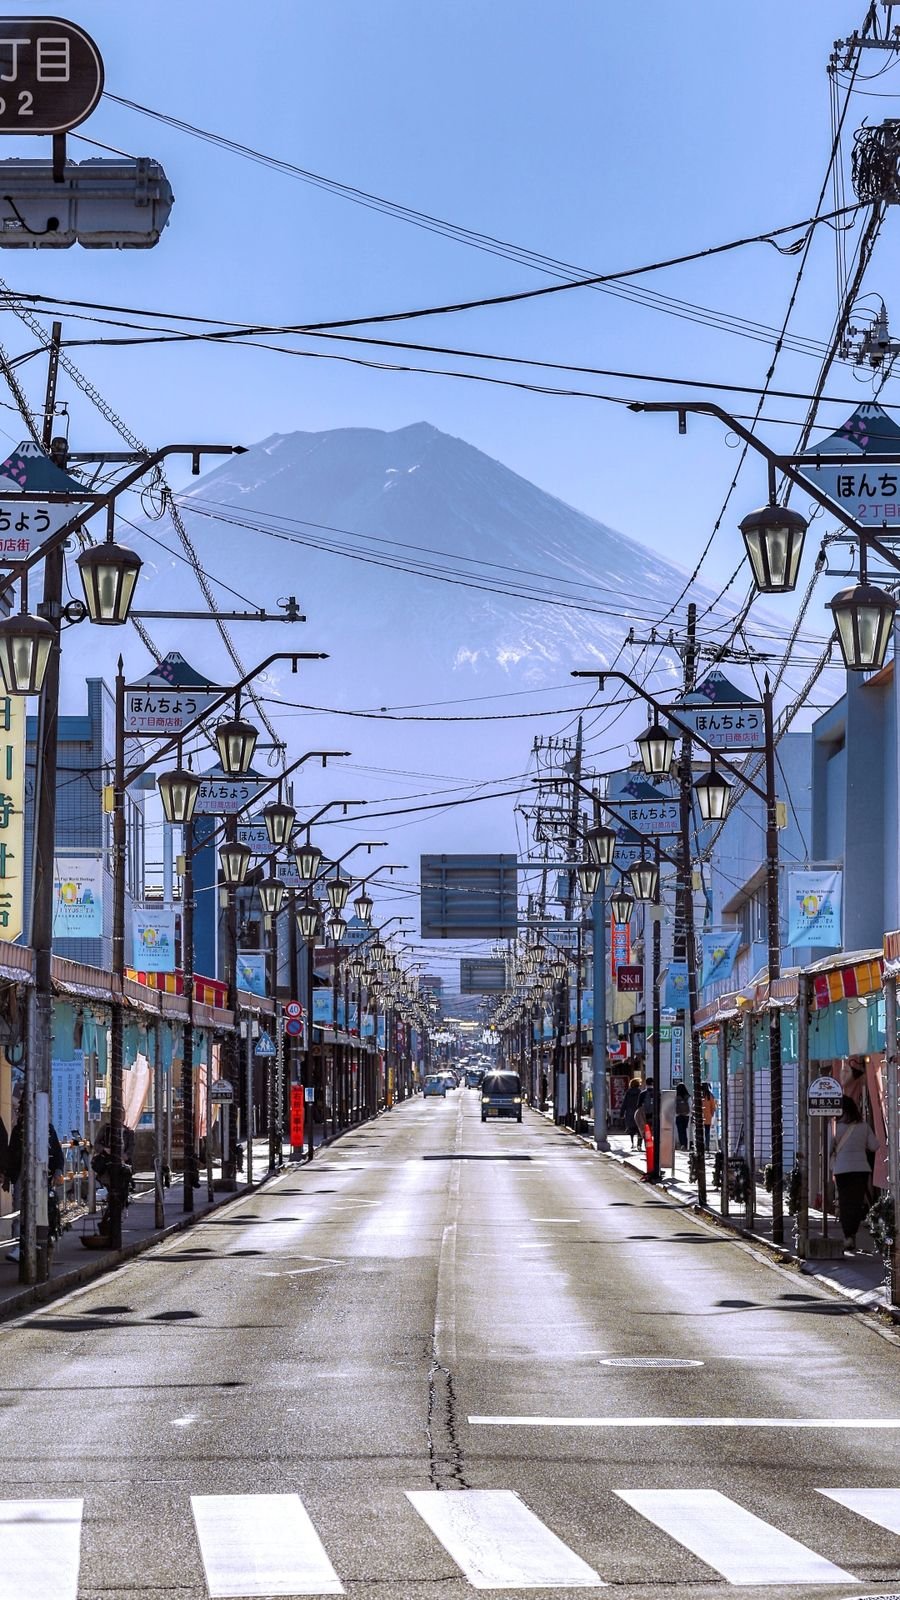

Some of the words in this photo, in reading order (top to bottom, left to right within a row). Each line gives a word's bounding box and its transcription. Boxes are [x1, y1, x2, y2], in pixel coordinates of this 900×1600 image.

[17, 91, 34, 116] 2
[0, 539, 30, 552] 店街
[130, 697, 197, 714] ほんちょう
[130, 717, 183, 727] 2丁目商店街
[696, 714, 759, 731] ほんちょう
[709, 732, 760, 743] 2丁目商店街
[197, 787, 249, 799] ほんちょう
[629, 807, 677, 821] ほんちょう
[288, 1005, 299, 1014] 40
